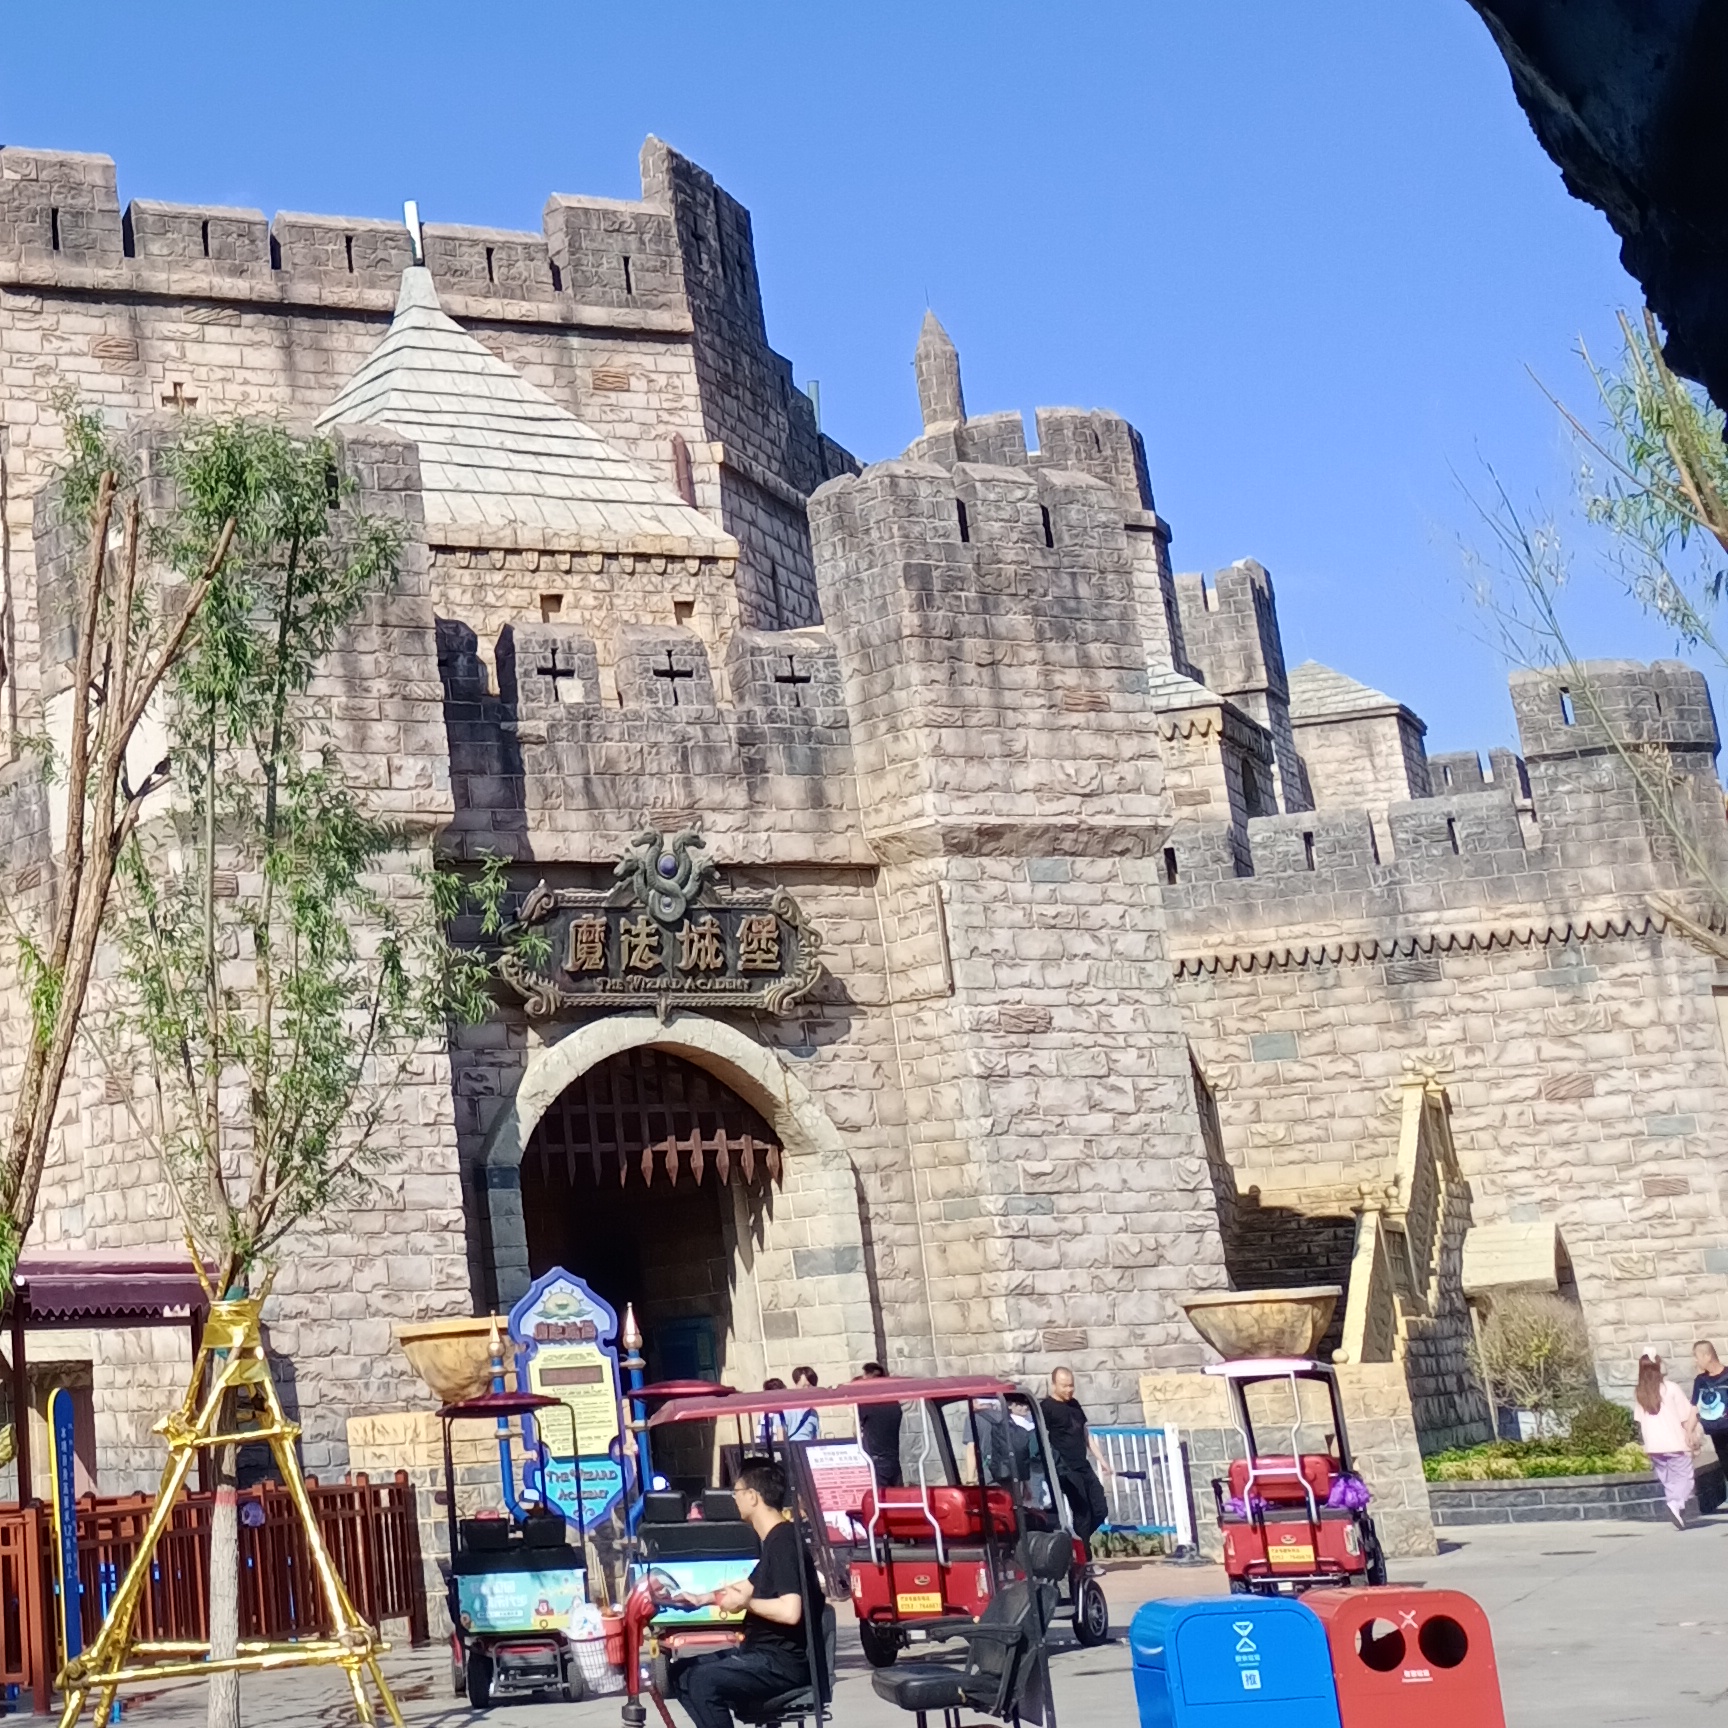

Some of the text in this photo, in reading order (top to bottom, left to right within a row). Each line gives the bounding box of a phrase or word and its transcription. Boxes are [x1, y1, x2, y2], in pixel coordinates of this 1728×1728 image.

[564, 913, 781, 971] 魔法城堡
[595, 974, 751, 990] THE WIZARD ACADEMY
